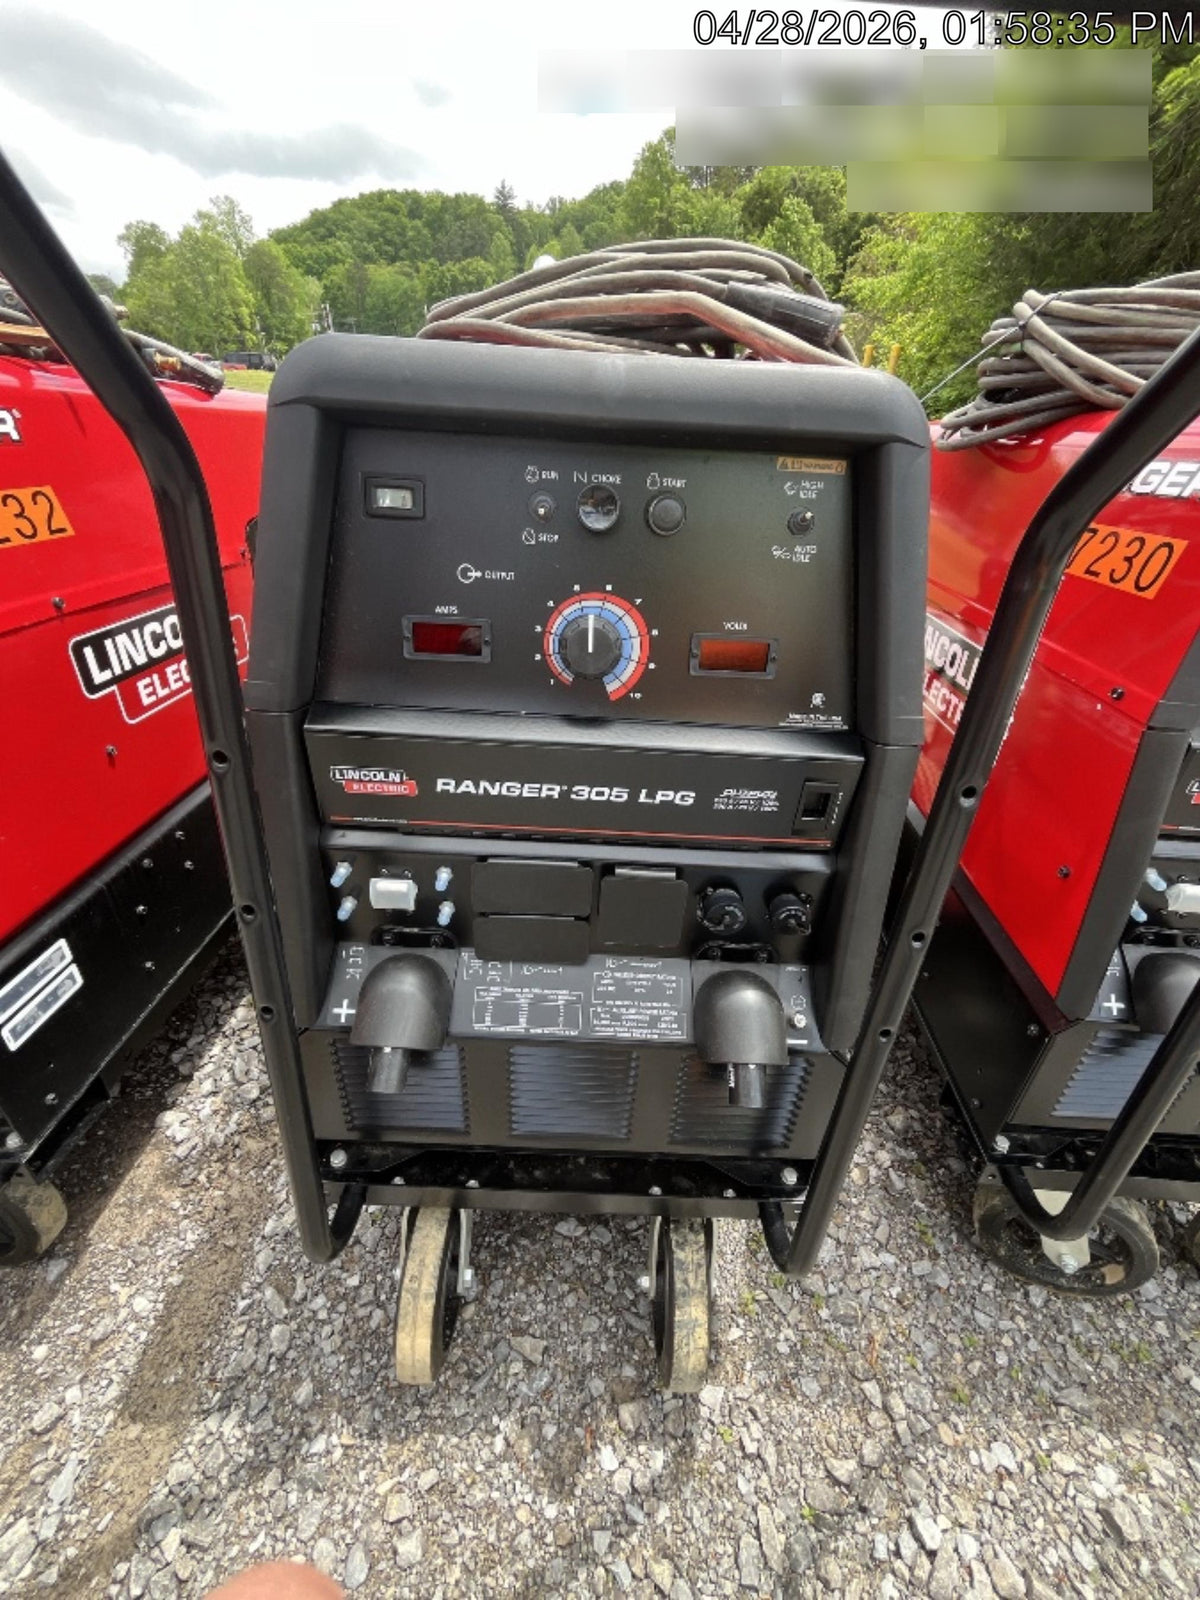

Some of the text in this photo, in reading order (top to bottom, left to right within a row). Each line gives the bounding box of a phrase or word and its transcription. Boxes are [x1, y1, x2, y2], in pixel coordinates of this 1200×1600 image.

[591, 474, 621, 484] CHOKE
[662, 477, 687, 488] START
[0, 490, 68, 545] 32
[537, 532, 559, 543] STOP
[484, 570, 515, 580] OUTPUT
[83, 614, 184, 685] LINCO
[925, 625, 980, 691] NCOL
[136, 659, 191, 707] ELEC
[923, 673, 965, 725] LECT
[335, 768, 401, 783] LINCOLN
[353, 782, 410, 794] ELECTRIC
[435, 778, 560, 800] RANGER
[570, 785, 630, 802] 305
[638, 788, 696, 806] LPG
